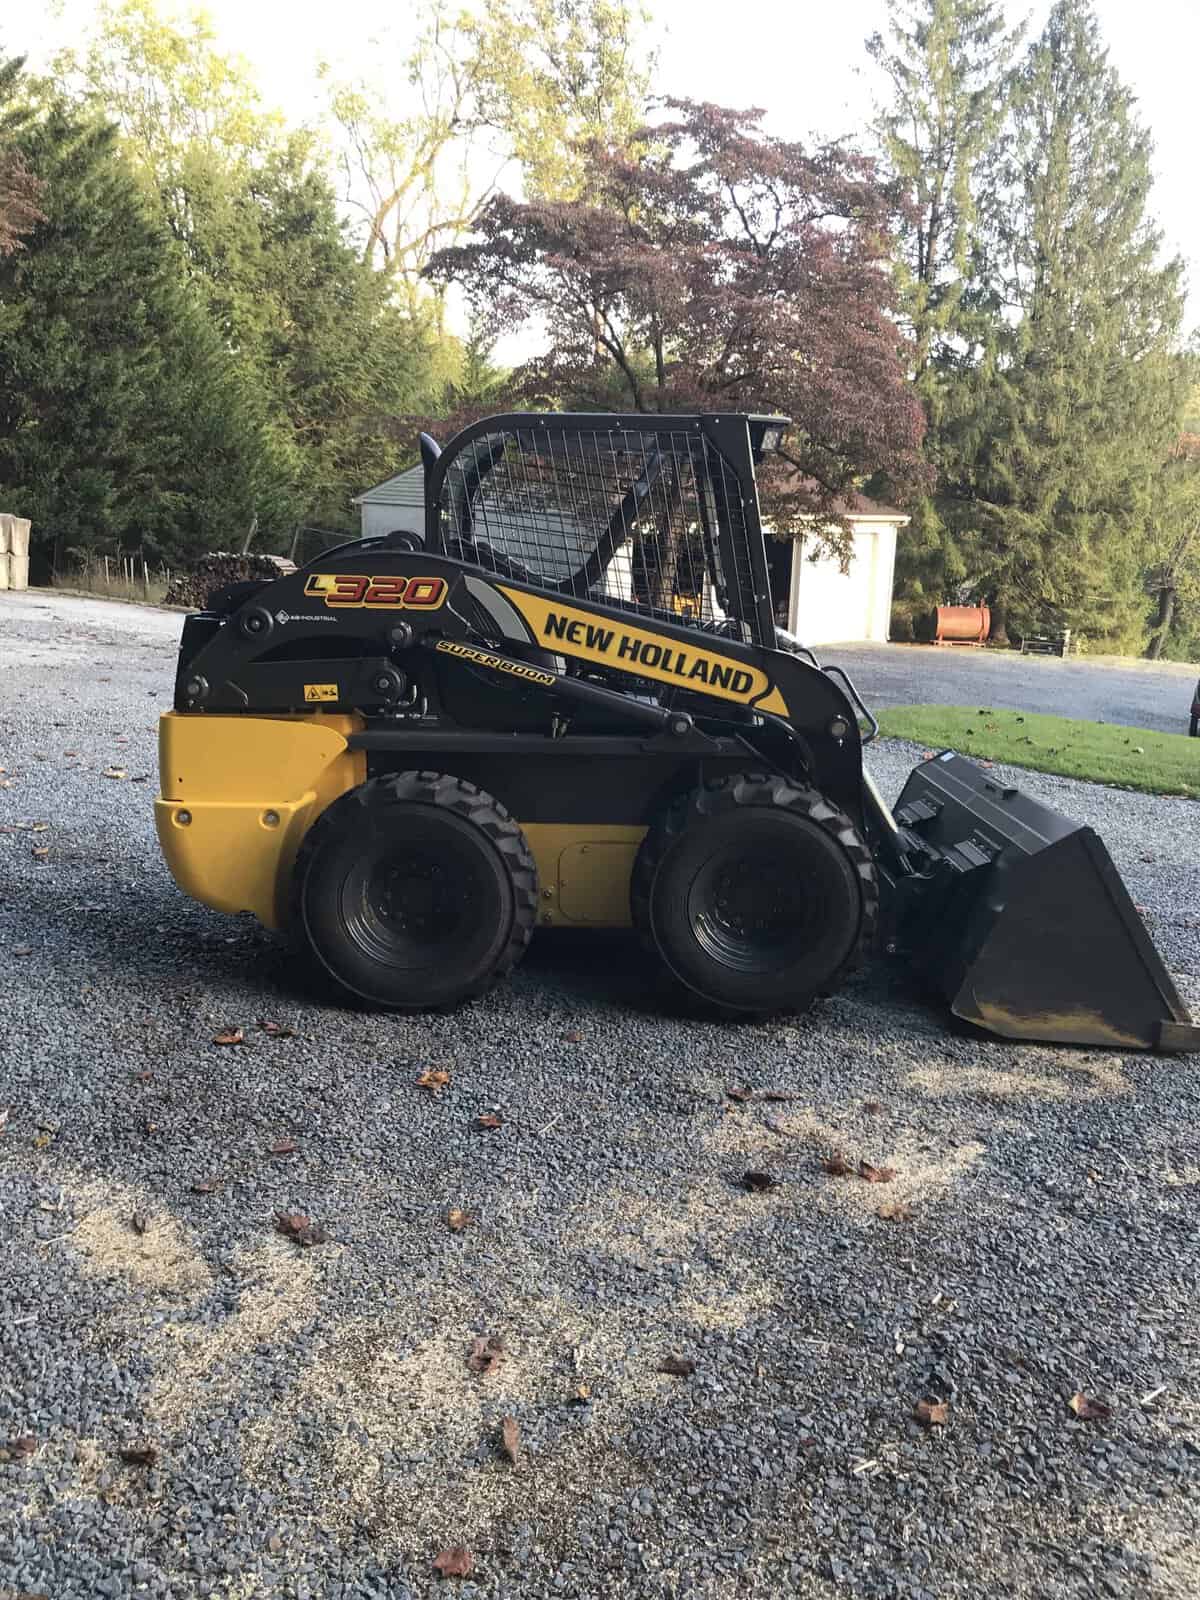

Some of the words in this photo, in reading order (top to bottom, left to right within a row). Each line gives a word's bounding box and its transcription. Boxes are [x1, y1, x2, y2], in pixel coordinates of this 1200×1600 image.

[305, 575, 446, 608] L320
[438, 641, 499, 667] SUPER
[500, 662, 555, 684] BOOM
[543, 613, 614, 653] NEW
[617, 636, 754, 694] HOLLAND
